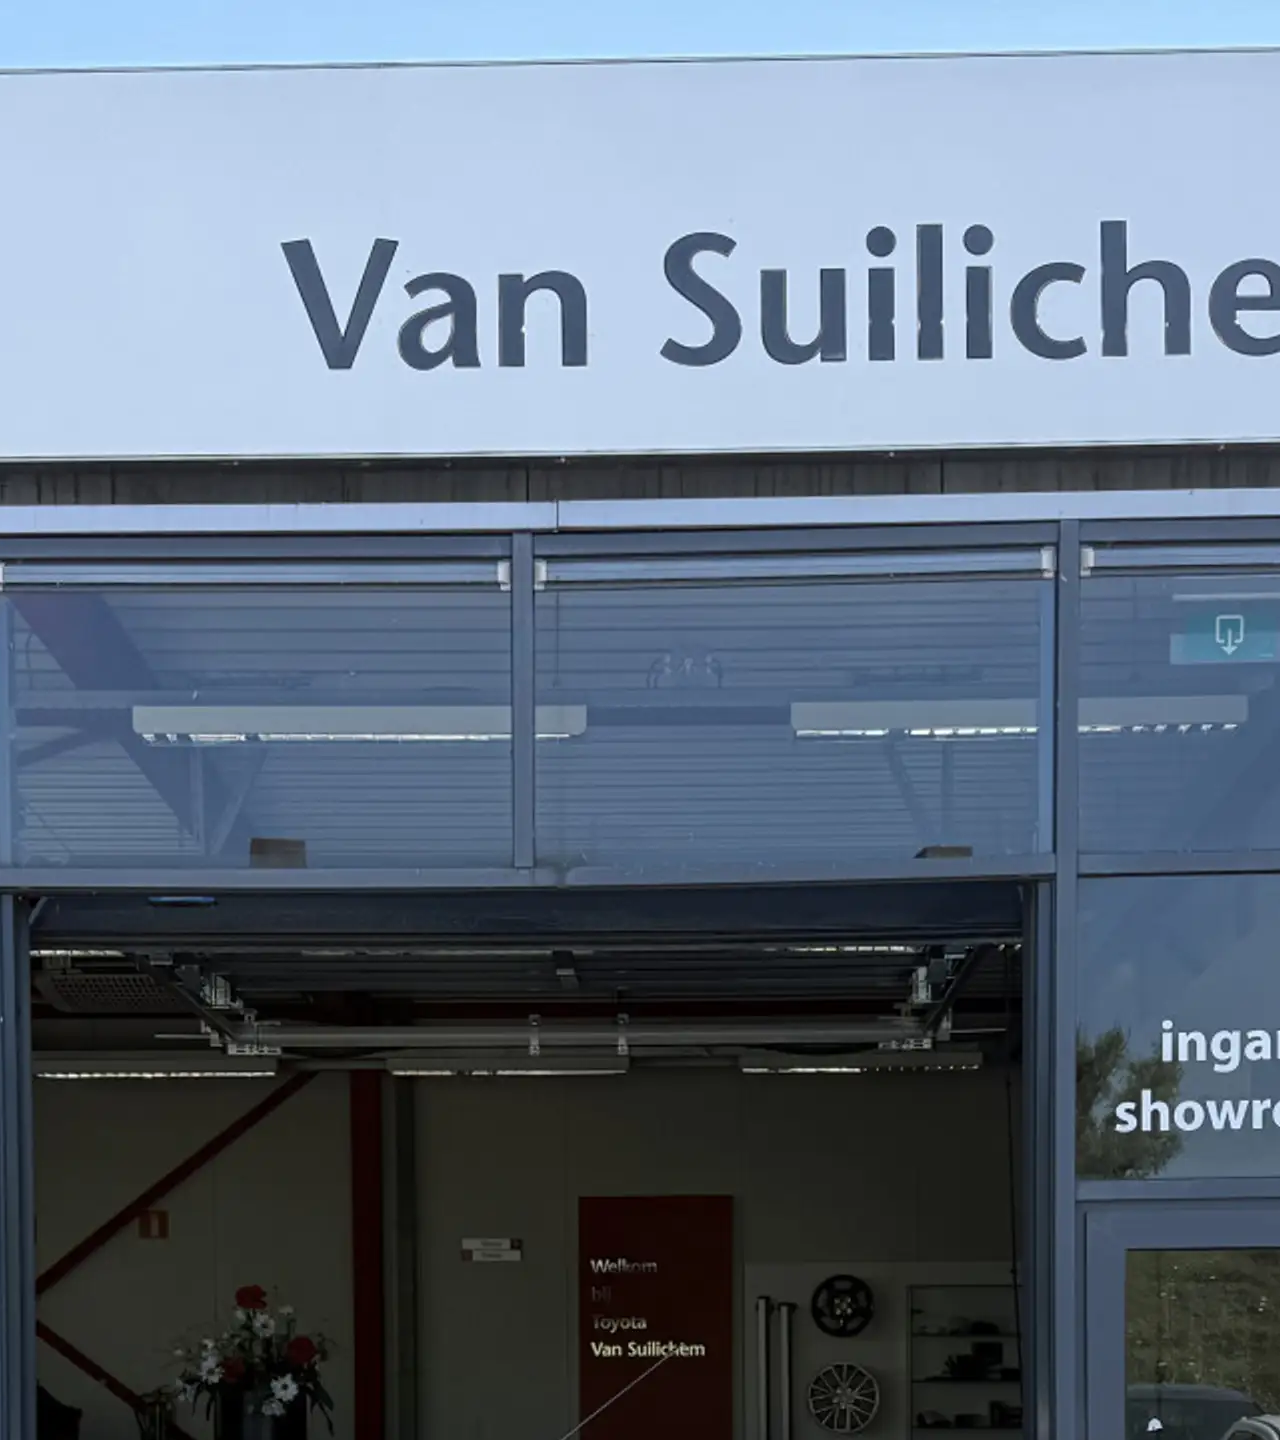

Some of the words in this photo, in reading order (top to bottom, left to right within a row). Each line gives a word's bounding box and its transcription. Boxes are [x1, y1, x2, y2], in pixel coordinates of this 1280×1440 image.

[281, 238, 587, 370] Van
[590, 1258, 657, 1273] Welkom
[592, 1314, 648, 1334] Toyota
[590, 1341, 623, 1357] Van
[627, 1340, 706, 1358] Suilichem
